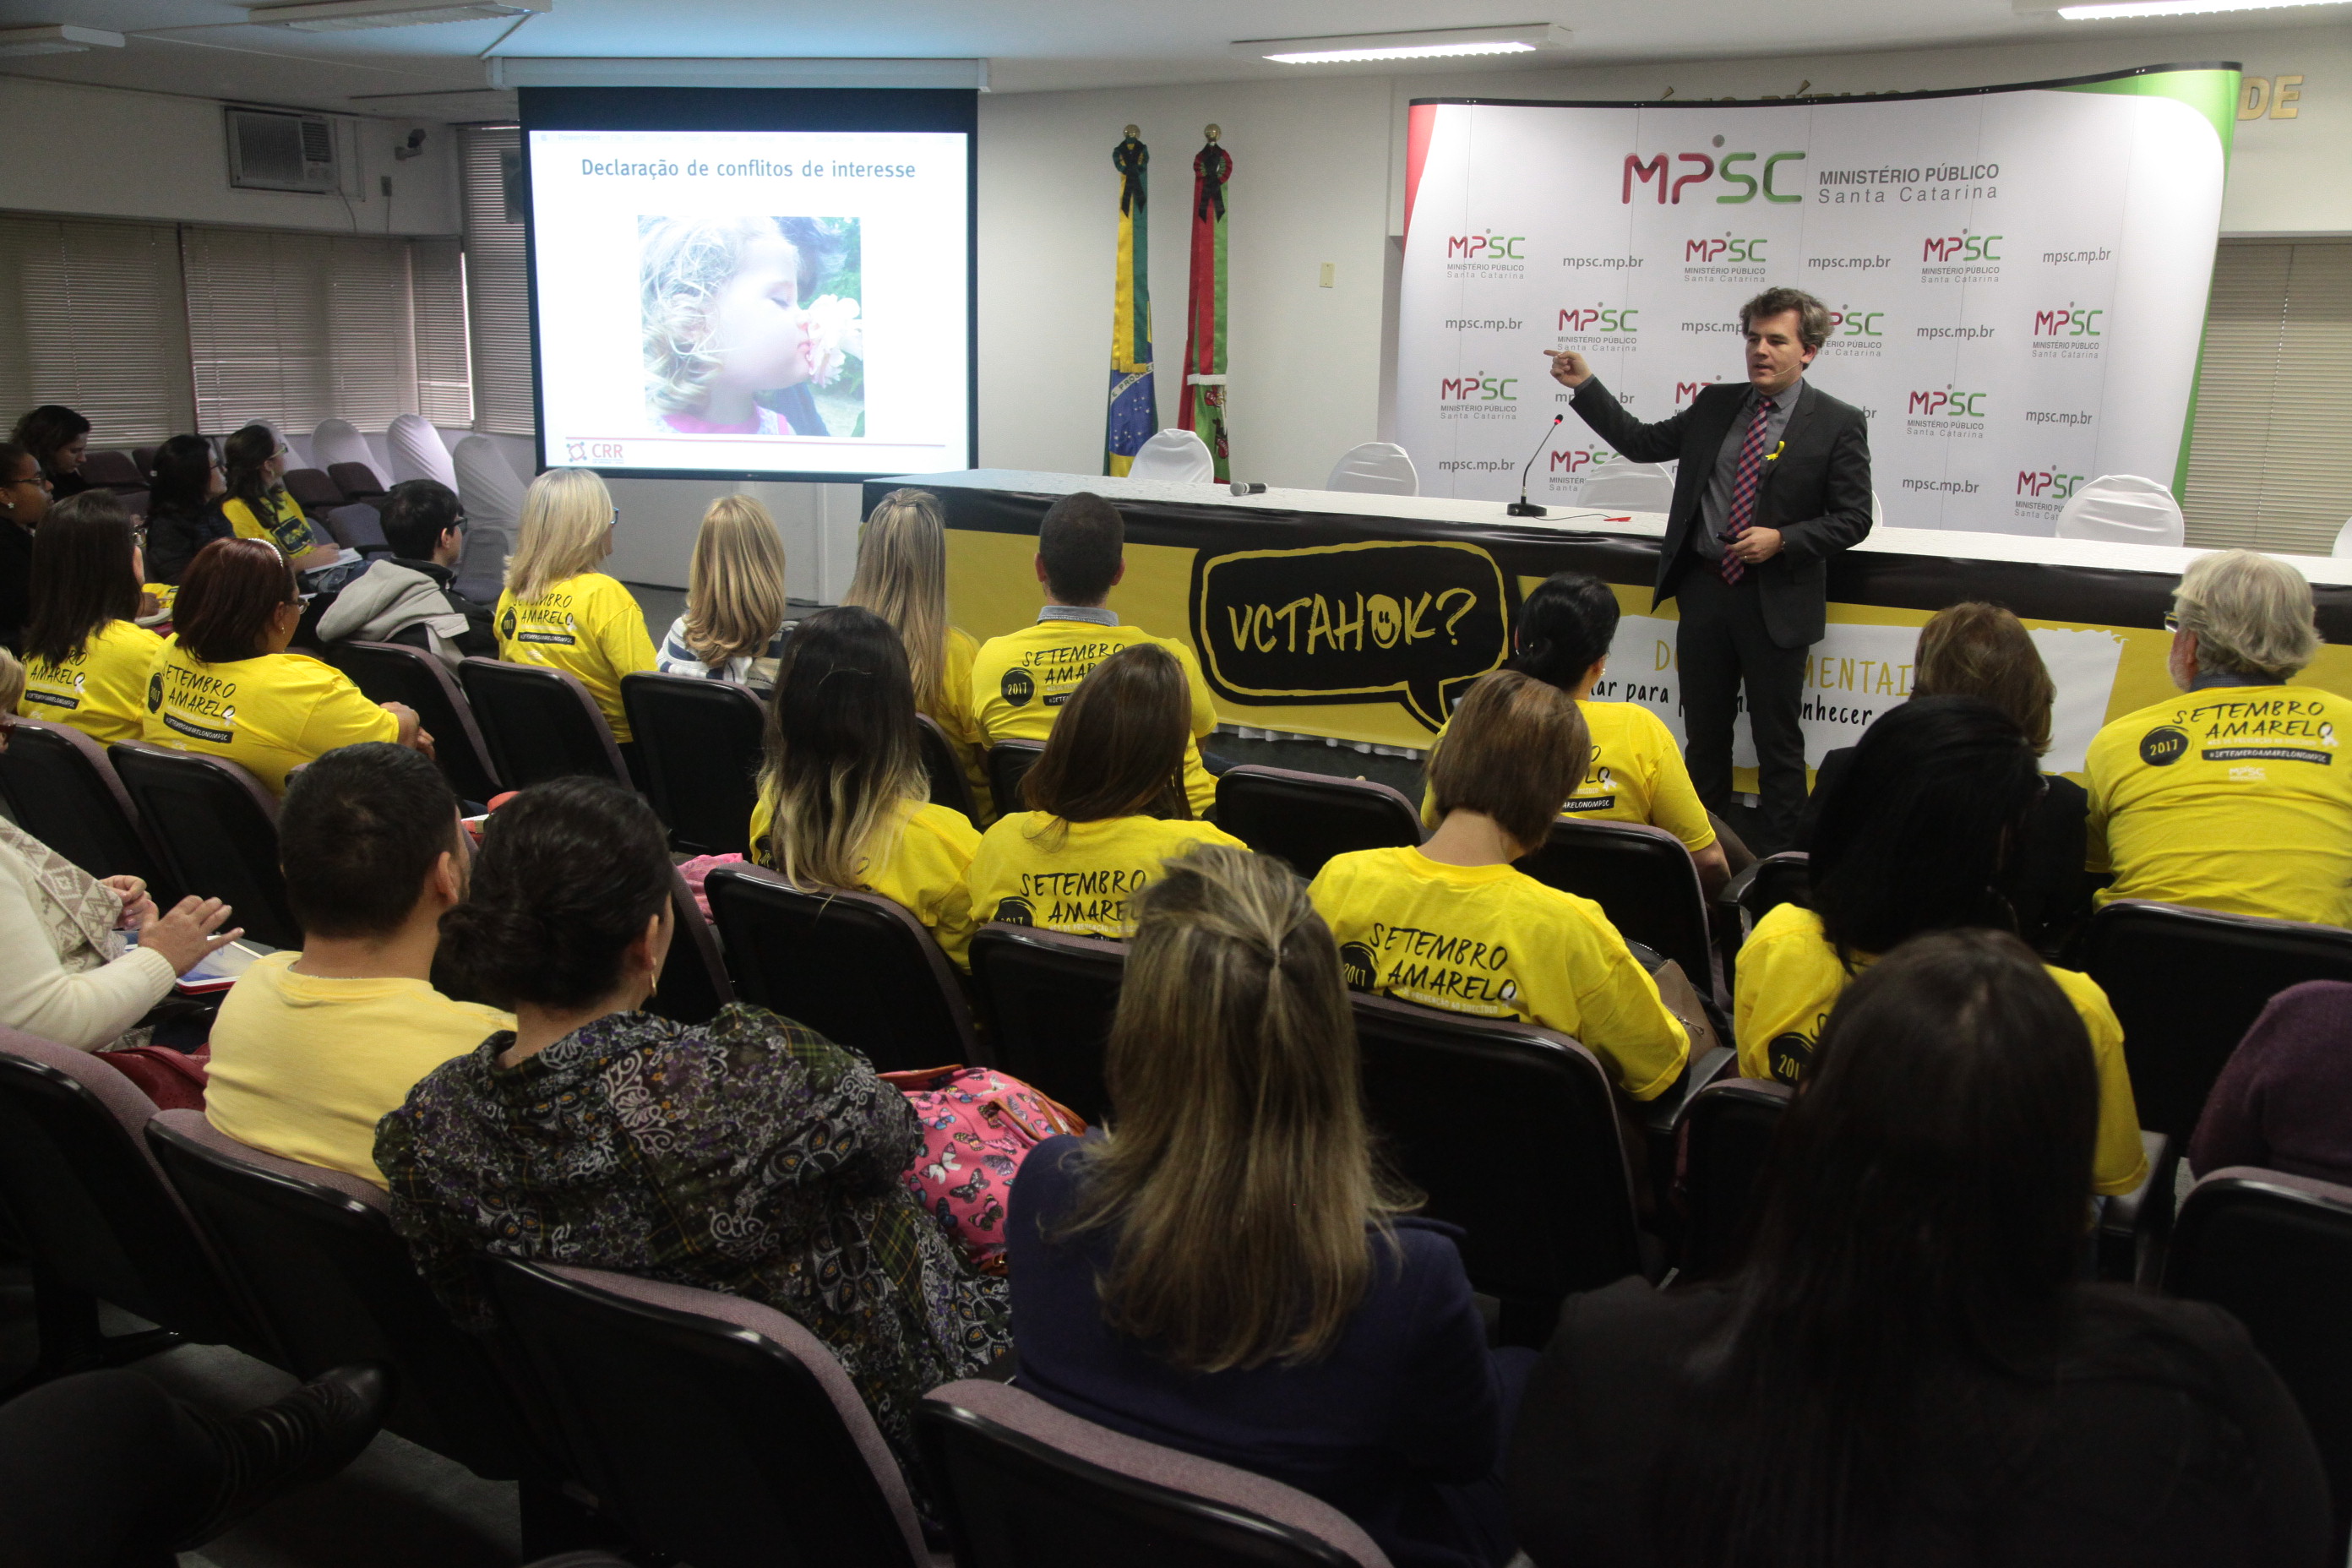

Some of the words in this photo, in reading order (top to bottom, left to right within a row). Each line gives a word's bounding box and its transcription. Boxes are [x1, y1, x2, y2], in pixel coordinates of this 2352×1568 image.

[2237, 75, 2304, 121] DE
[581, 158, 678, 181] Declaração
[687, 159, 709, 177] de
[717, 160, 793, 177] conflitos
[802, 161, 824, 177] de
[832, 161, 916, 178] interesse
[1622, 151, 1806, 204] MPSC
[1819, 165, 1919, 185] MINISTÉRIO
[1925, 162, 2000, 182] PÚBLICO
[1818, 188, 1885, 204] Santa
[1900, 184, 1997, 202] Catarina
[1448, 236, 1525, 259] MPSC
[1685, 238, 1767, 263] MPSC
[1923, 236, 2003, 262] MPSC
[2043, 247, 2111, 265] mpsc.mp.br
[1447, 262, 1489, 270] MINISTÉRIO
[1491, 263, 1524, 271] PÚBLICO
[1563, 255, 1643, 270] mpsc.mp.br
[1684, 266, 1729, 275] MINISTÉRIO
[1731, 266, 1766, 275] PÚBLICO
[1808, 255, 1891, 270] mpsc.mp.br
[1922, 266, 1963, 275] MINISTÉRIO
[1965, 265, 2000, 274] PÚBLICO
[1481, 271, 1524, 280] Catarina
[1720, 275, 1765, 283] Catarina
[1446, 318, 1522, 332] mpsc.mp.br
[1558, 309, 1639, 332] MPSC
[1681, 322, 1743, 335] mpsc.mp
[1829, 312, 1884, 335] PSC
[2034, 310, 2103, 335] MPSC
[1557, 335, 1601, 344] MINISTÉRIO
[1917, 324, 1995, 340] mpsc.mp.br
[1835, 348, 1881, 357] Catarina
[1848, 340, 1881, 348] PÚBLICO
[2033, 340, 2070, 349] MINISTÉRIO
[2072, 340, 2099, 350] PÚBLICO
[2032, 350, 2057, 358] Santa
[2061, 350, 2099, 359] Catarina
[1441, 378, 1518, 400] MPSC
[1484, 404, 1516, 412] PÚBLICO
[1908, 390, 1986, 416] MPSC
[1907, 419, 1948, 428] MINISTÉRIO
[1951, 421, 1984, 430] PÚBLICO
[2026, 411, 2093, 427] mpsc.mp.br
[1907, 427, 1934, 436] Santa
[1940, 429, 1983, 438] Catarina
[591, 444, 623, 458] CRR
[1439, 458, 1515, 473] mpsc.mp.br
[1903, 478, 1979, 494] mpsc.mp.br
[2015, 509, 2039, 519] Santa
[521, 609, 574, 626] AMARELO
[1022, 643, 1125, 667] SETEMBRO
[1045, 662, 1097, 684] AMAR
[1008, 682, 1027, 695] 2017
[168, 687, 236, 719] AMARELO
[1626, 683, 1669, 703] para
[1803, 694, 1872, 725] nhecer
[2172, 700, 2325, 725] SETEMBRO
[2205, 719, 2333, 739] AMARELO
[2149, 738, 2179, 757] 2017
[1020, 869, 1146, 897] SETEMBRO
[1048, 900, 1141, 924] AMAREL
[1369, 923, 1508, 971] SETEMBRO
[1344, 963, 1366, 987] 2017
[1387, 960, 1516, 1001] AMARELO
[1778, 1054, 1799, 1081] 201
